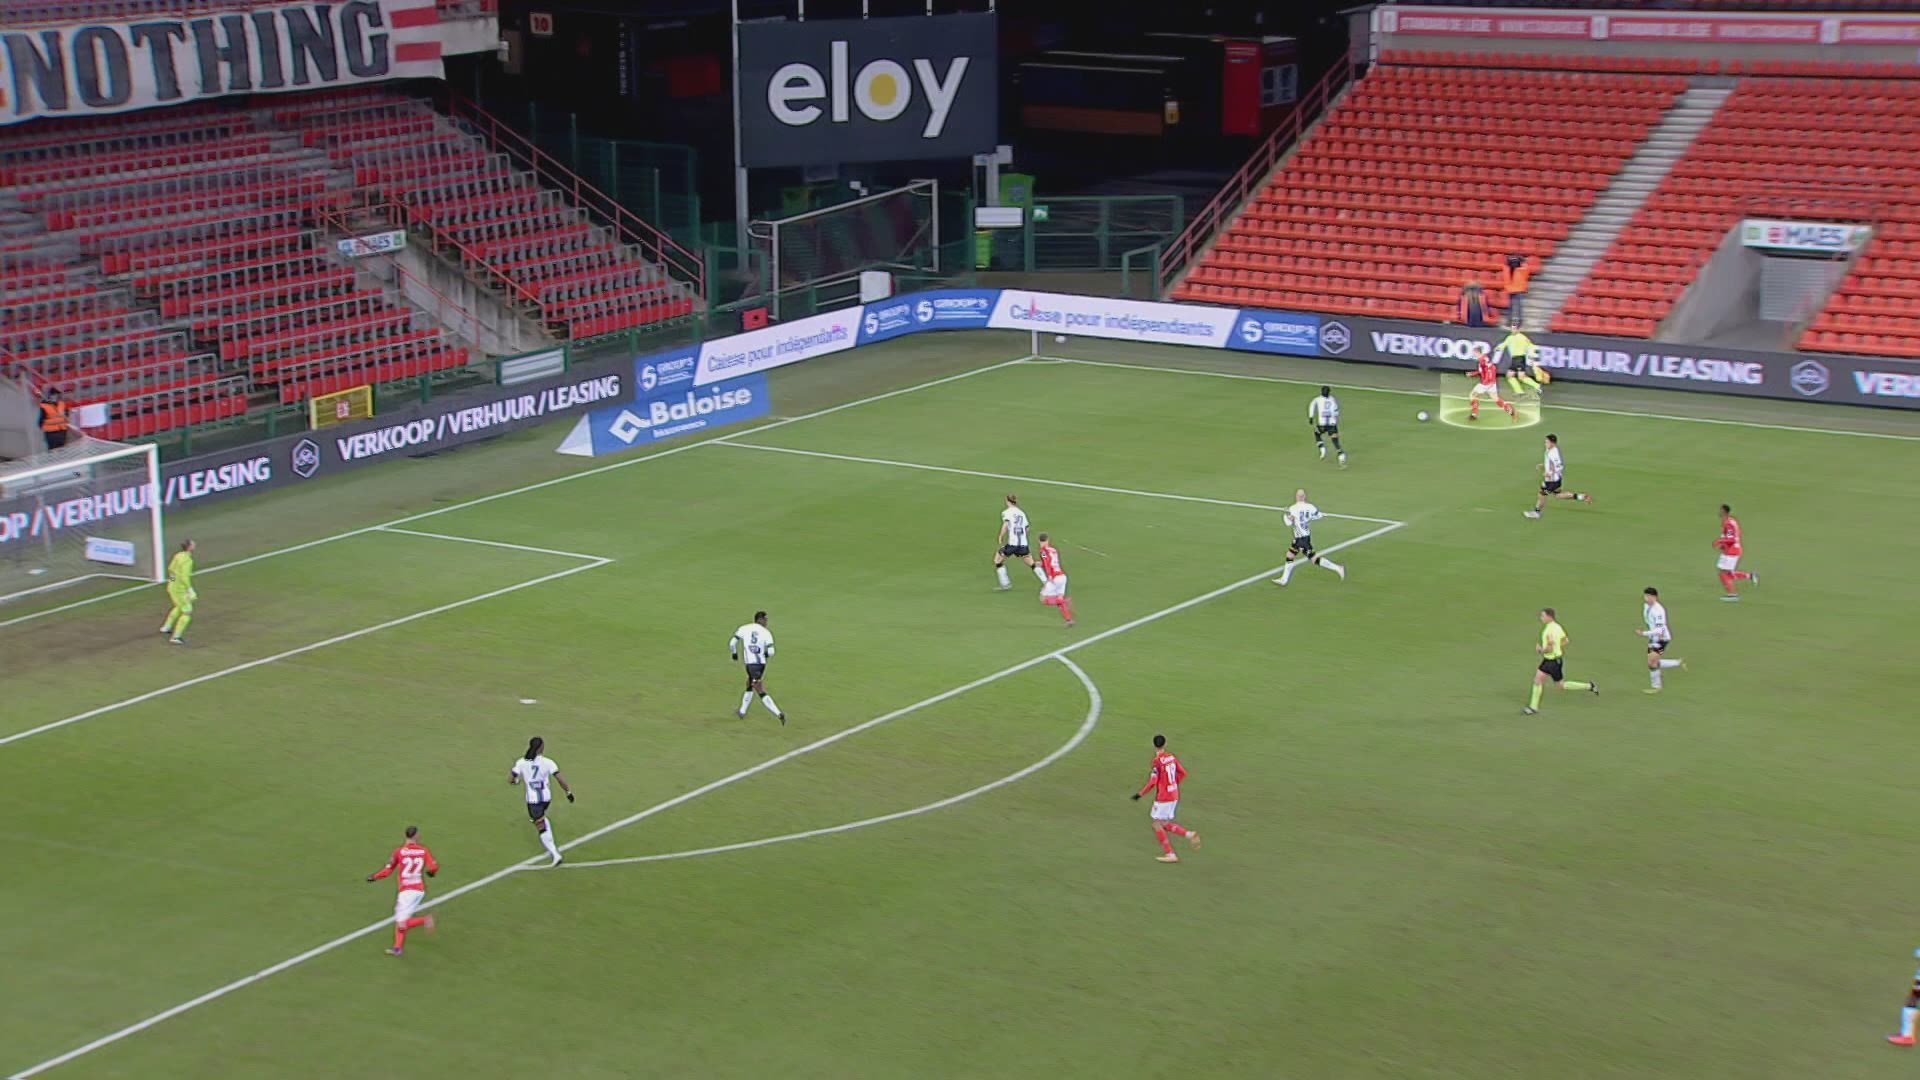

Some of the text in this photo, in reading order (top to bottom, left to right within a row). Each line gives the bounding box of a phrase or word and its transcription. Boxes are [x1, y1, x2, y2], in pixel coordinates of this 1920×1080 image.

[533, 15, 550, 32] 10
[3, 1, 391, 116] NOTHING
[767, 41, 970, 138] eloy
[1784, 226, 1846, 246] MAES
[1009, 304, 1063, 324] Caisse
[1064, 309, 1101, 328] pour
[1103, 312, 1215, 337] indépendants
[707, 326, 849, 372] Caisse pour indépendants
[1526, 345, 1633, 373] ERHUUR
[1648, 353, 1763, 384] LEASING
[337, 418, 434, 461] VERKOOP
[447, 395, 536, 434] VERHUUR
[548, 375, 621, 412] LEASING
[650, 386, 752, 426] Baloise
[178, 456, 271, 500] LEASING
[531, 765, 539, 779] 7
[402, 857, 424, 878] 22
